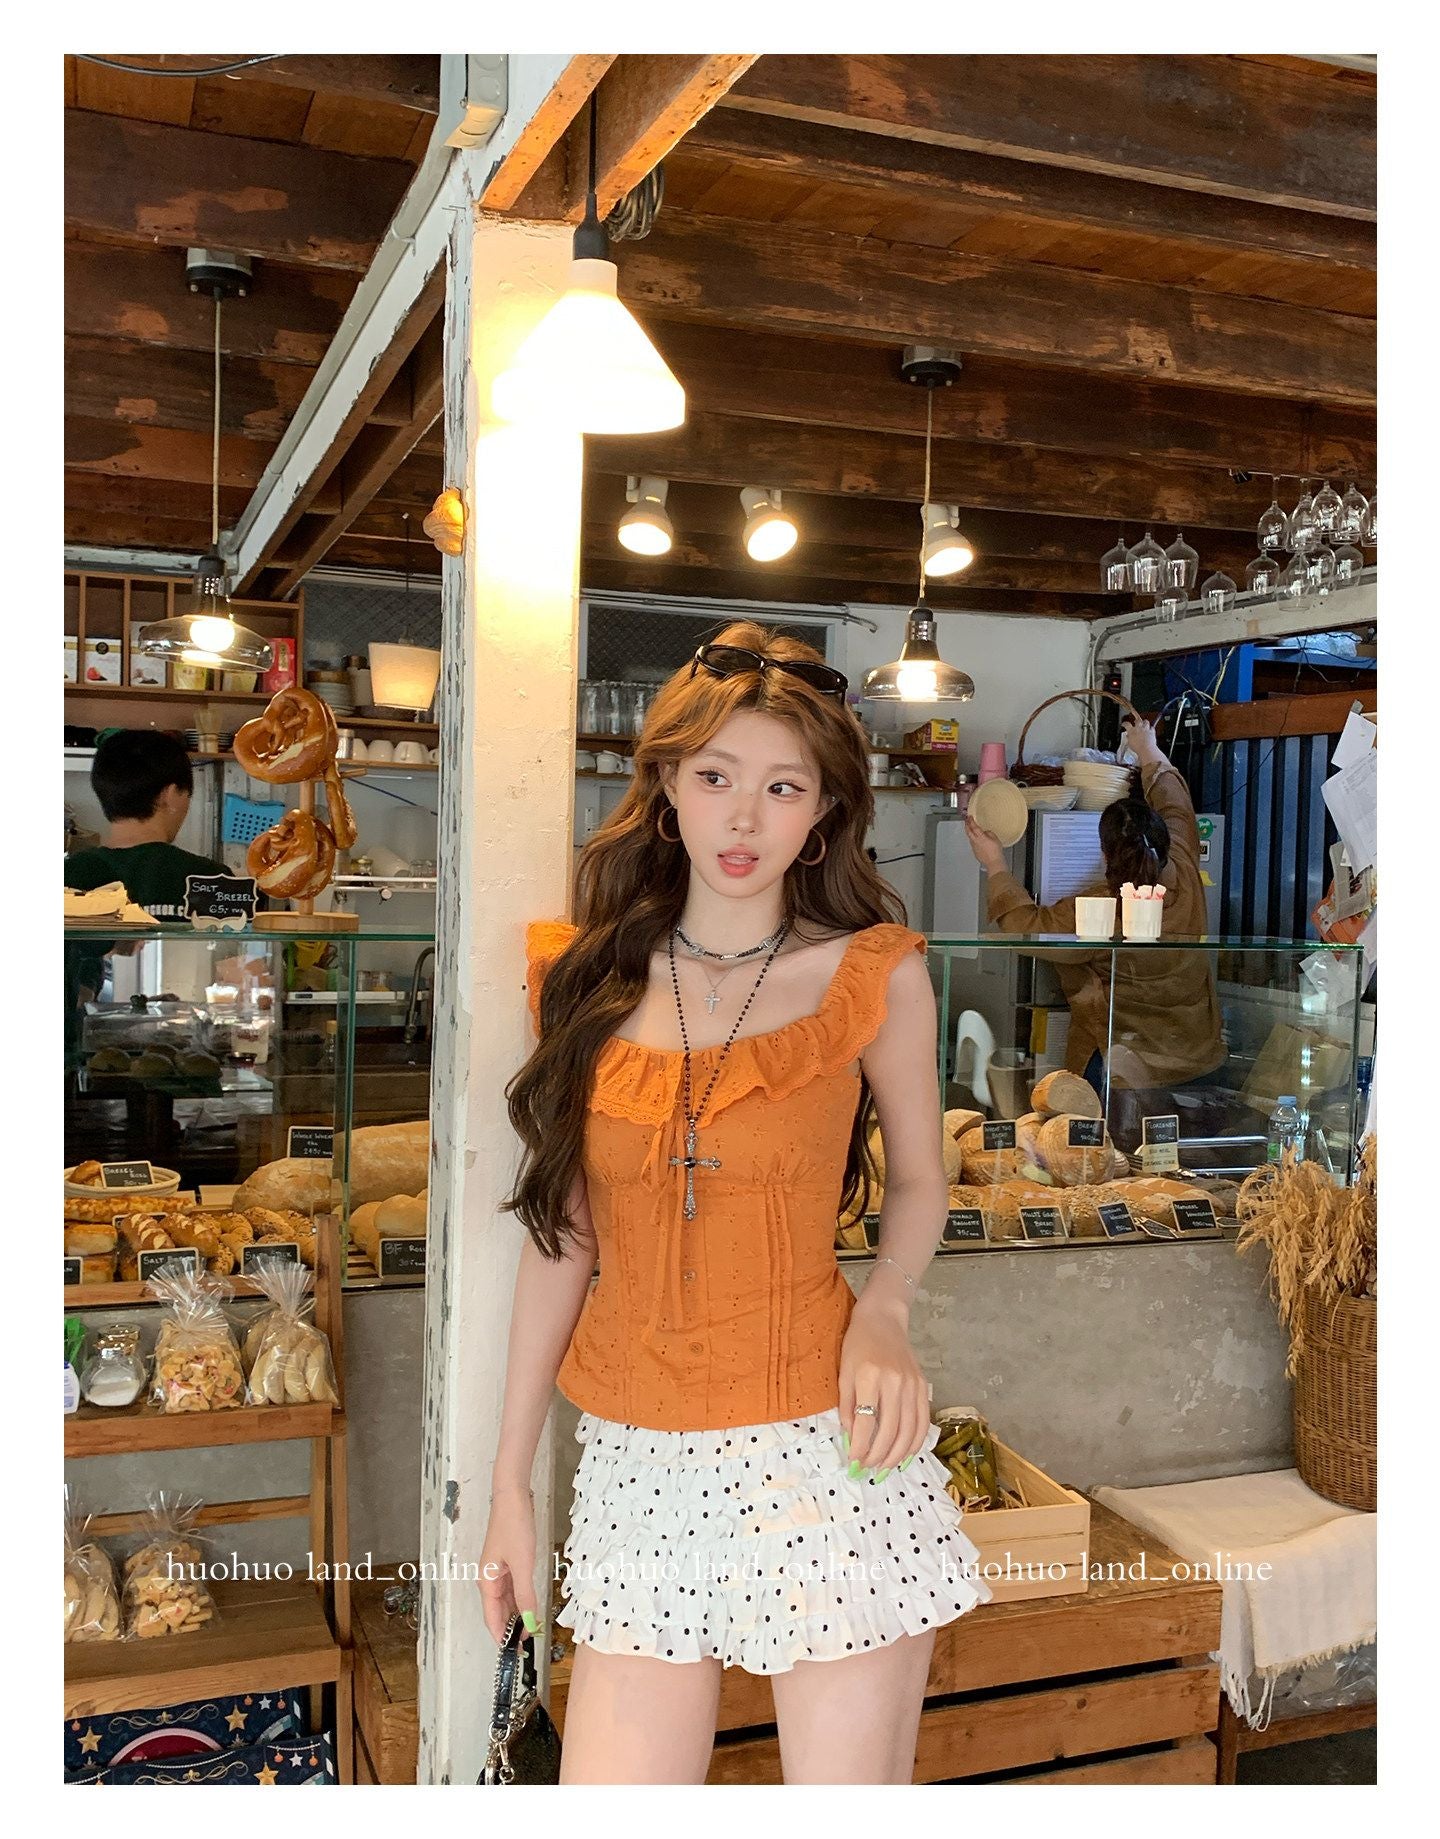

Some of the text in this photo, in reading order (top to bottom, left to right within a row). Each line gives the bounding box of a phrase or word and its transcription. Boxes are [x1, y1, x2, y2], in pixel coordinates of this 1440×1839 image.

[191, 881, 219, 893] SALT
[214, 891, 255, 902] BREZEL
[143, 1256, 165, 1265] SALT
